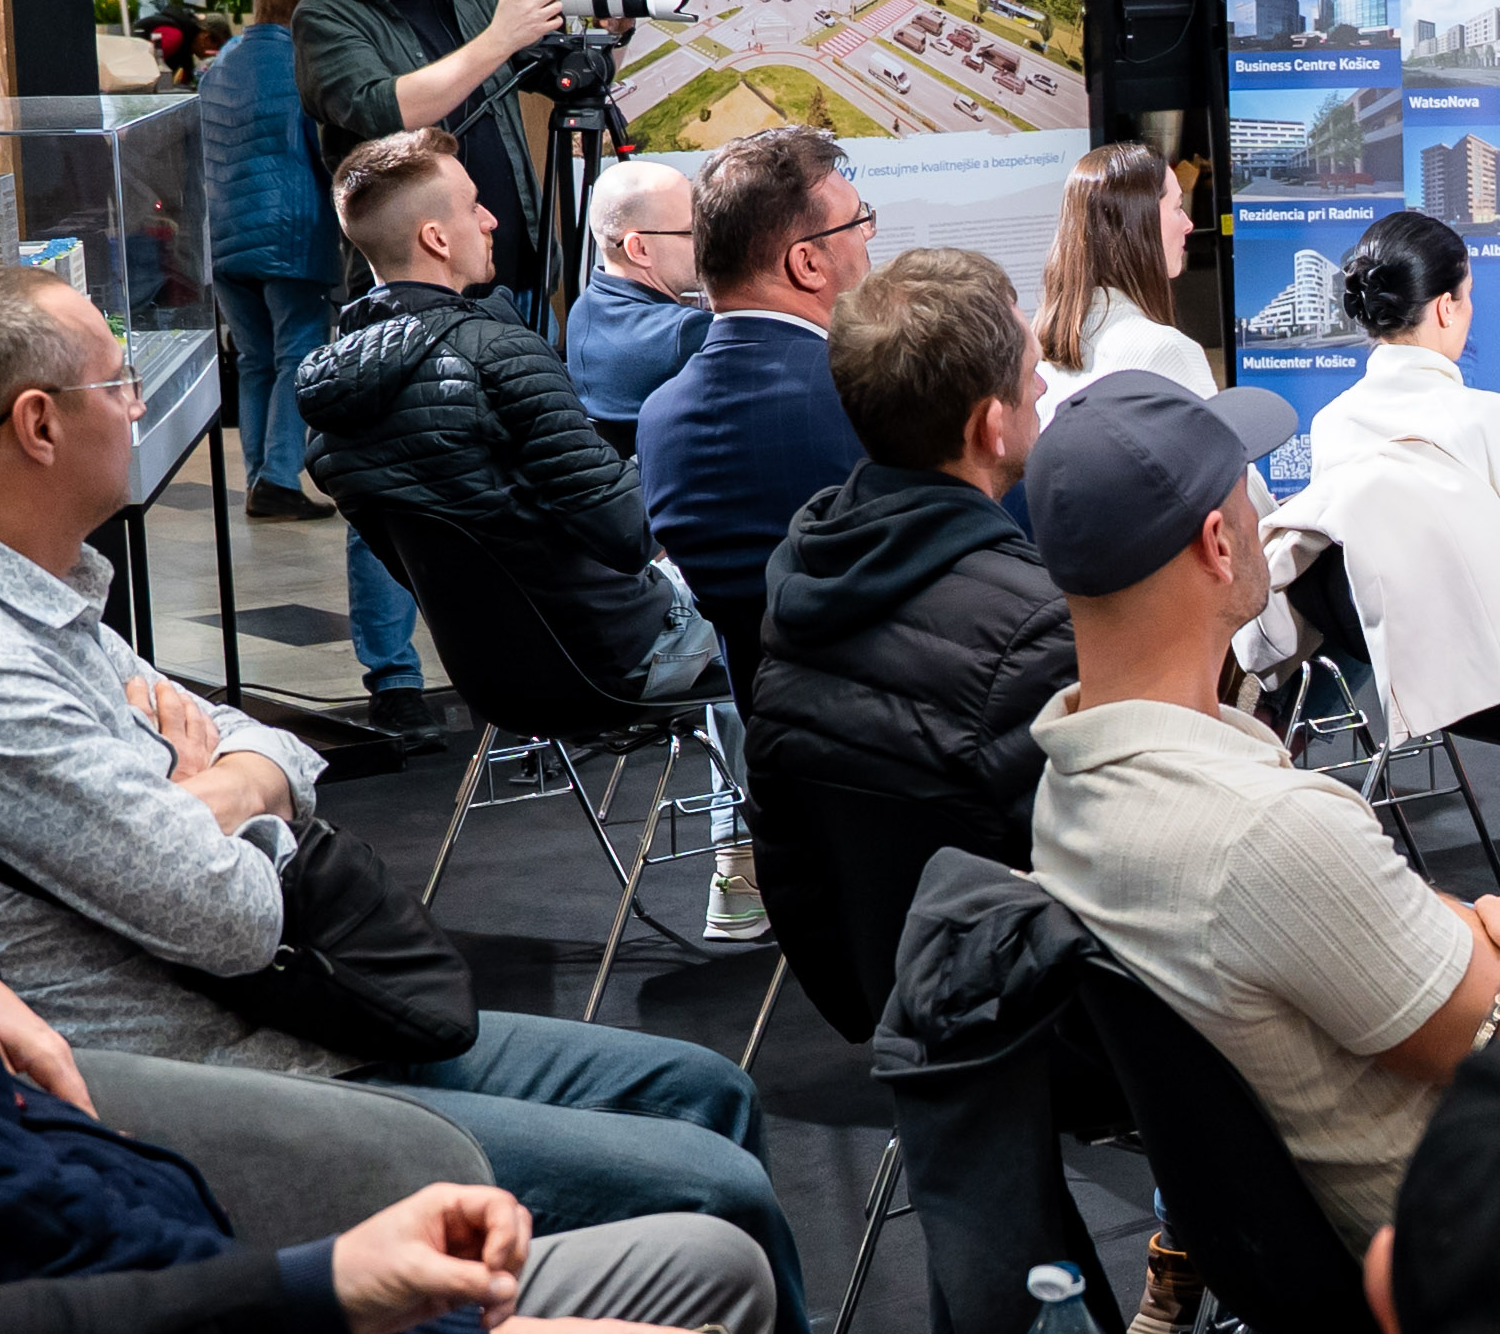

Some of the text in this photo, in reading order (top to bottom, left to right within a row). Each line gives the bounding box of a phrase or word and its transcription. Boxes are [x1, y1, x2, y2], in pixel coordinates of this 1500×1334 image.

[1235, 56, 1382, 73] Business Centre Košice
[1409, 96, 1480, 109] WatsoNova
[867, 163, 919, 178] cestujme
[921, 159, 981, 175] kvalitnejšie
[992, 152, 1060, 169] bezpečnejšie
[1239, 206, 1374, 223] Rezidencia pri Radnici
[1242, 354, 1357, 370] Multicenter Košice
